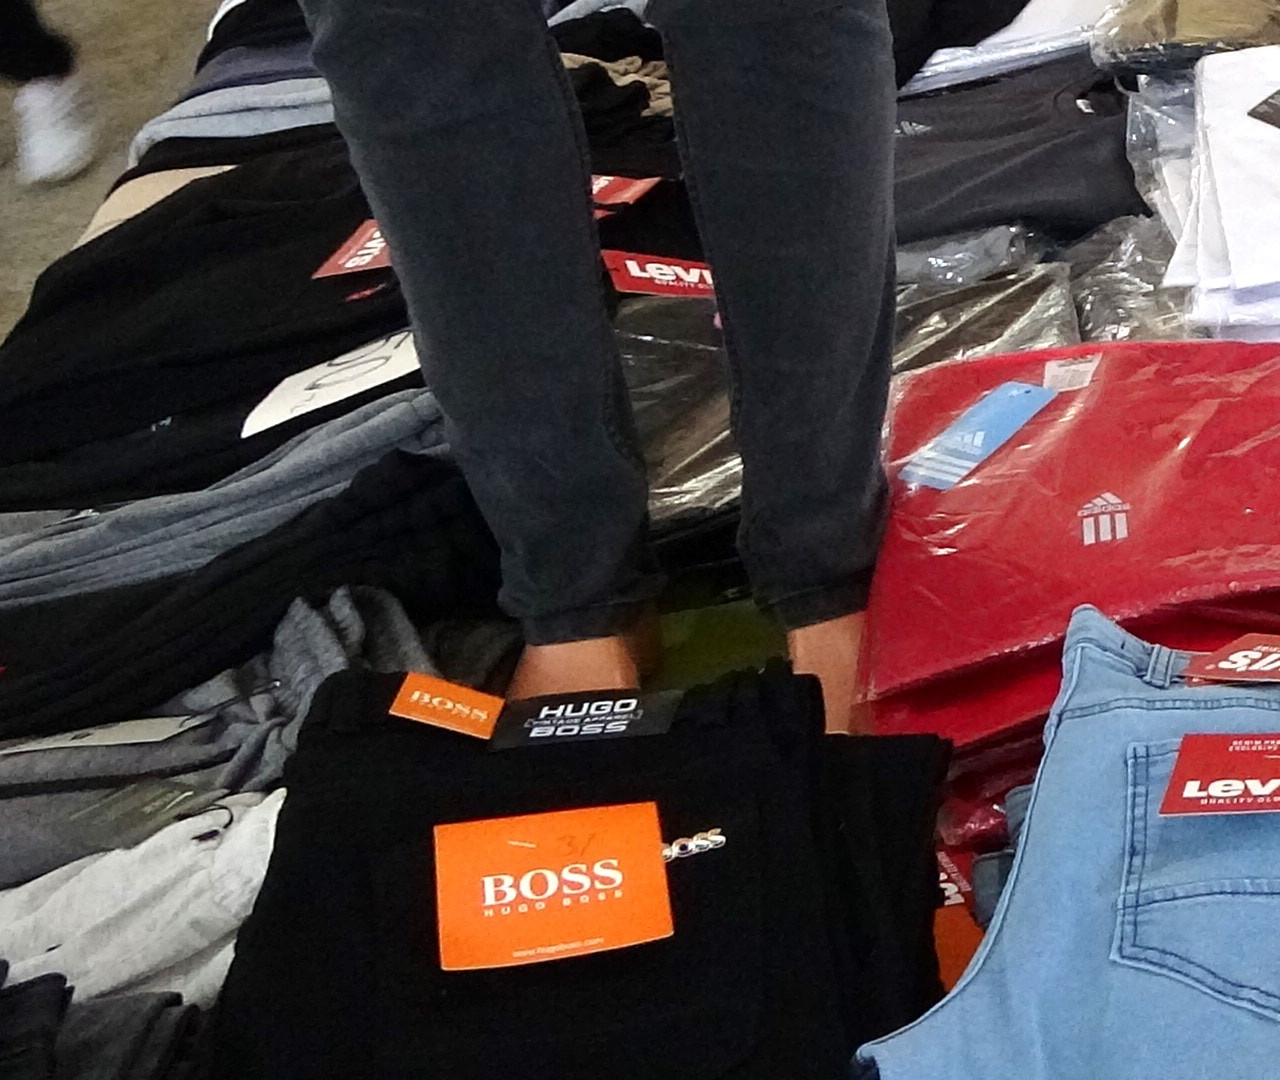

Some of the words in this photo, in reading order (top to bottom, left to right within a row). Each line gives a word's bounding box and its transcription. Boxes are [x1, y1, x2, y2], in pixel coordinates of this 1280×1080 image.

[410, 691, 489, 722] BOSS
[539, 698, 638, 719] HUGO
[529, 720, 630, 738] BOSS
[481, 858, 623, 907] BOSS
[484, 901, 546, 918] HUGO
[562, 888, 623, 908] BOSS
